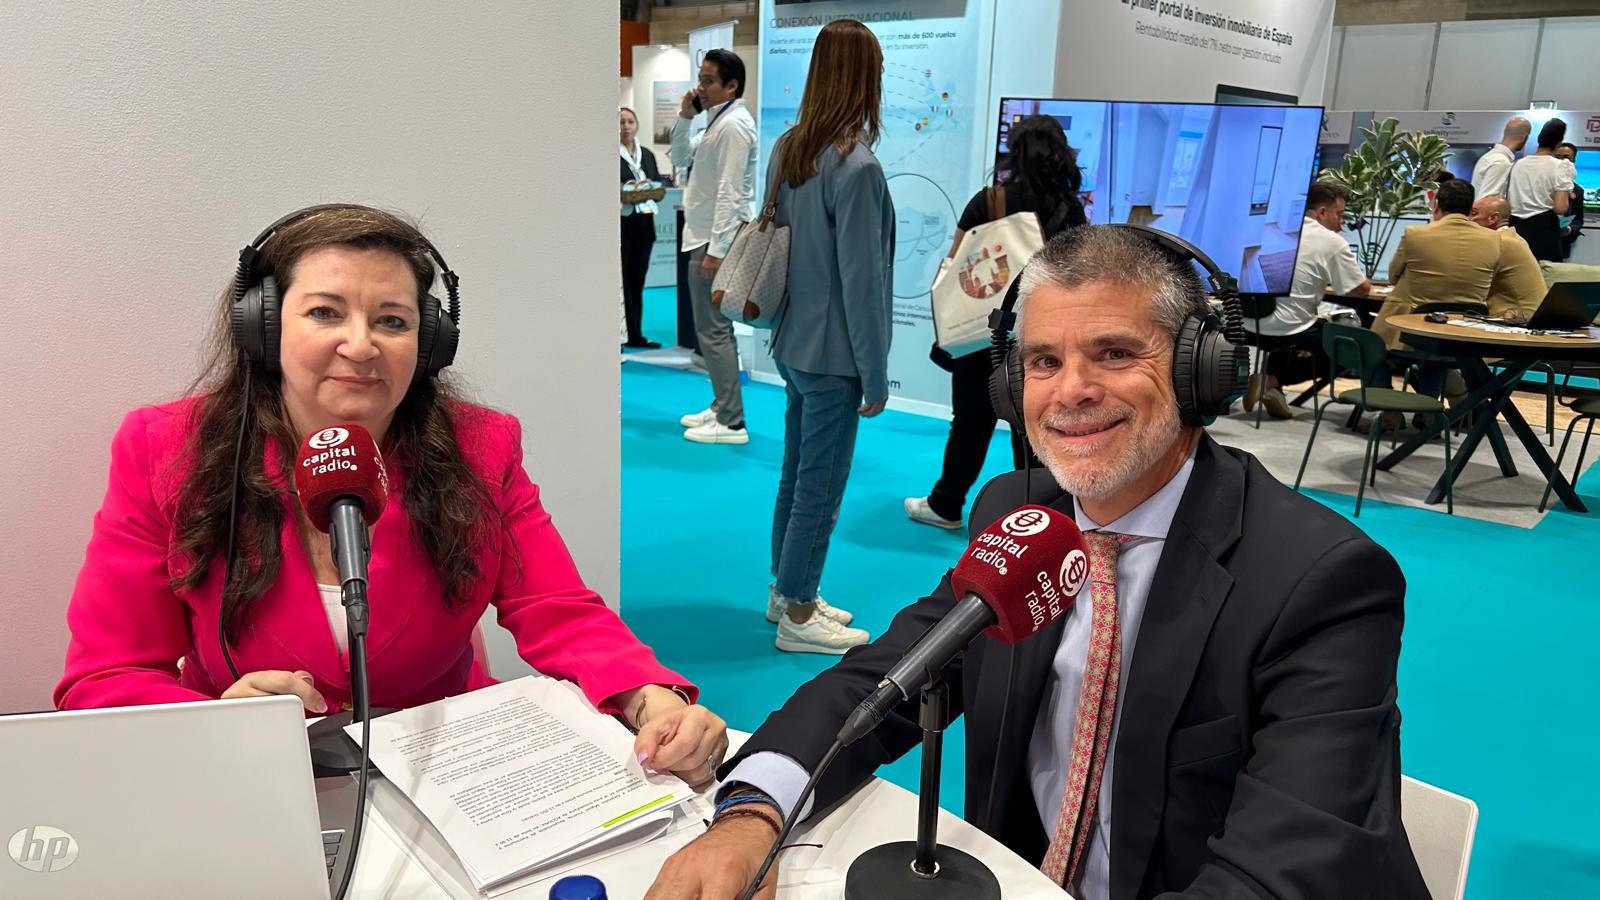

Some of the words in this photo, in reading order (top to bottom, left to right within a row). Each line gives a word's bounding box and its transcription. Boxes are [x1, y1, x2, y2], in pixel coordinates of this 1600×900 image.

[770, 14, 823, 29] CONEXIÓN
[1135, 20, 1179, 42] Rentabilidad
[1159, 1, 1182, 18] portal
[1183, 4, 1193, 21] de
[1194, 7, 1226, 29] inversión
[1227, 16, 1262, 38] inmobiliaria
[1263, 26, 1271, 40] de
[1271, 28, 1293, 46] España
[302, 445, 357, 468] capital
[977, 532, 1029, 559] capital
[1037, 571, 1063, 621] capital
[19, 825, 70, 872] hp
